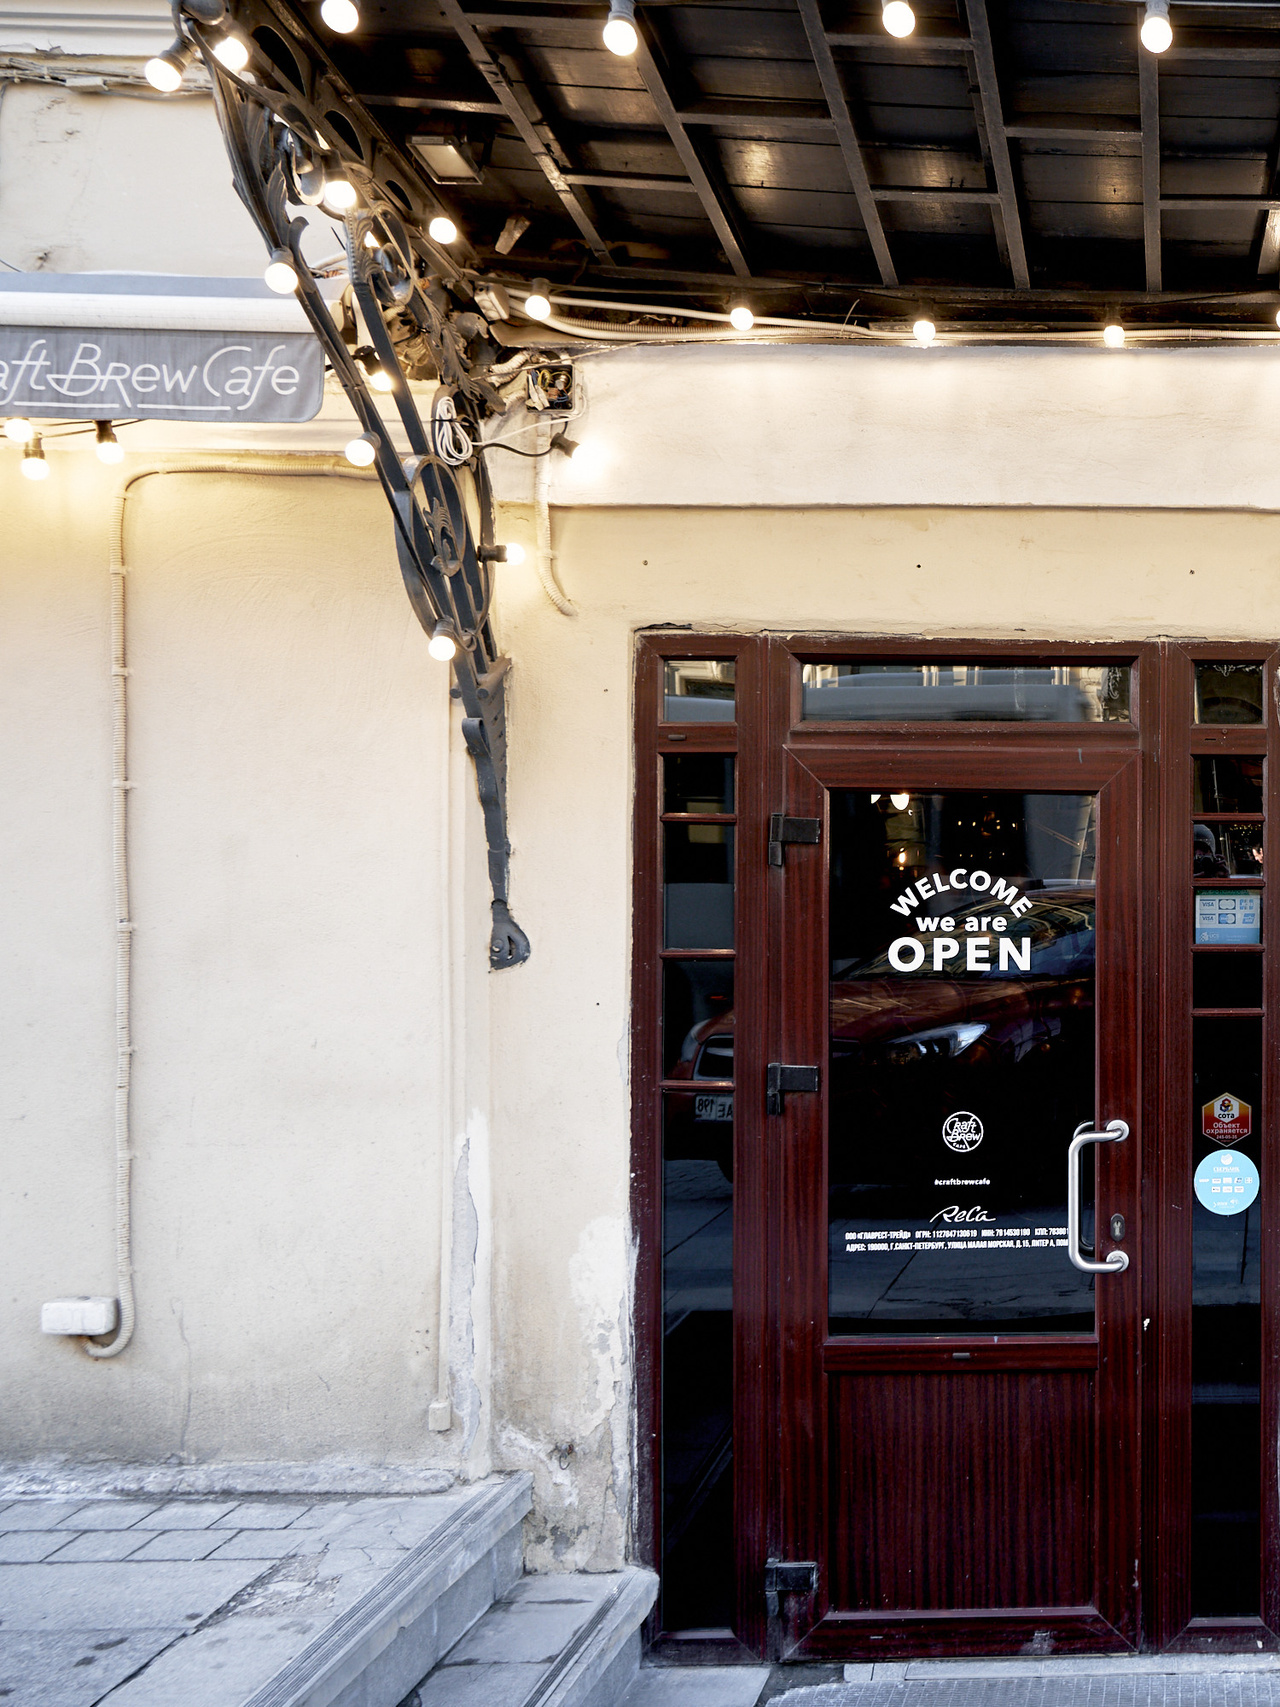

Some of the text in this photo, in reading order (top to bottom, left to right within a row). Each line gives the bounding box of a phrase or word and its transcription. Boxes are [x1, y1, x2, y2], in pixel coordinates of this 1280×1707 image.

[202, 344, 300, 411] Cafe
[889, 868, 1034, 919] WELCOME
[915, 916, 1008, 932] we are
[887, 936, 1031, 973] OPEN
[845, 1232, 857, 1240] ООО
[915, 1230, 932, 1239] ОГРН:
[846, 1243, 866, 1252] АДРЕС:
[947, 1241, 967, 1250] УЛИЦА
